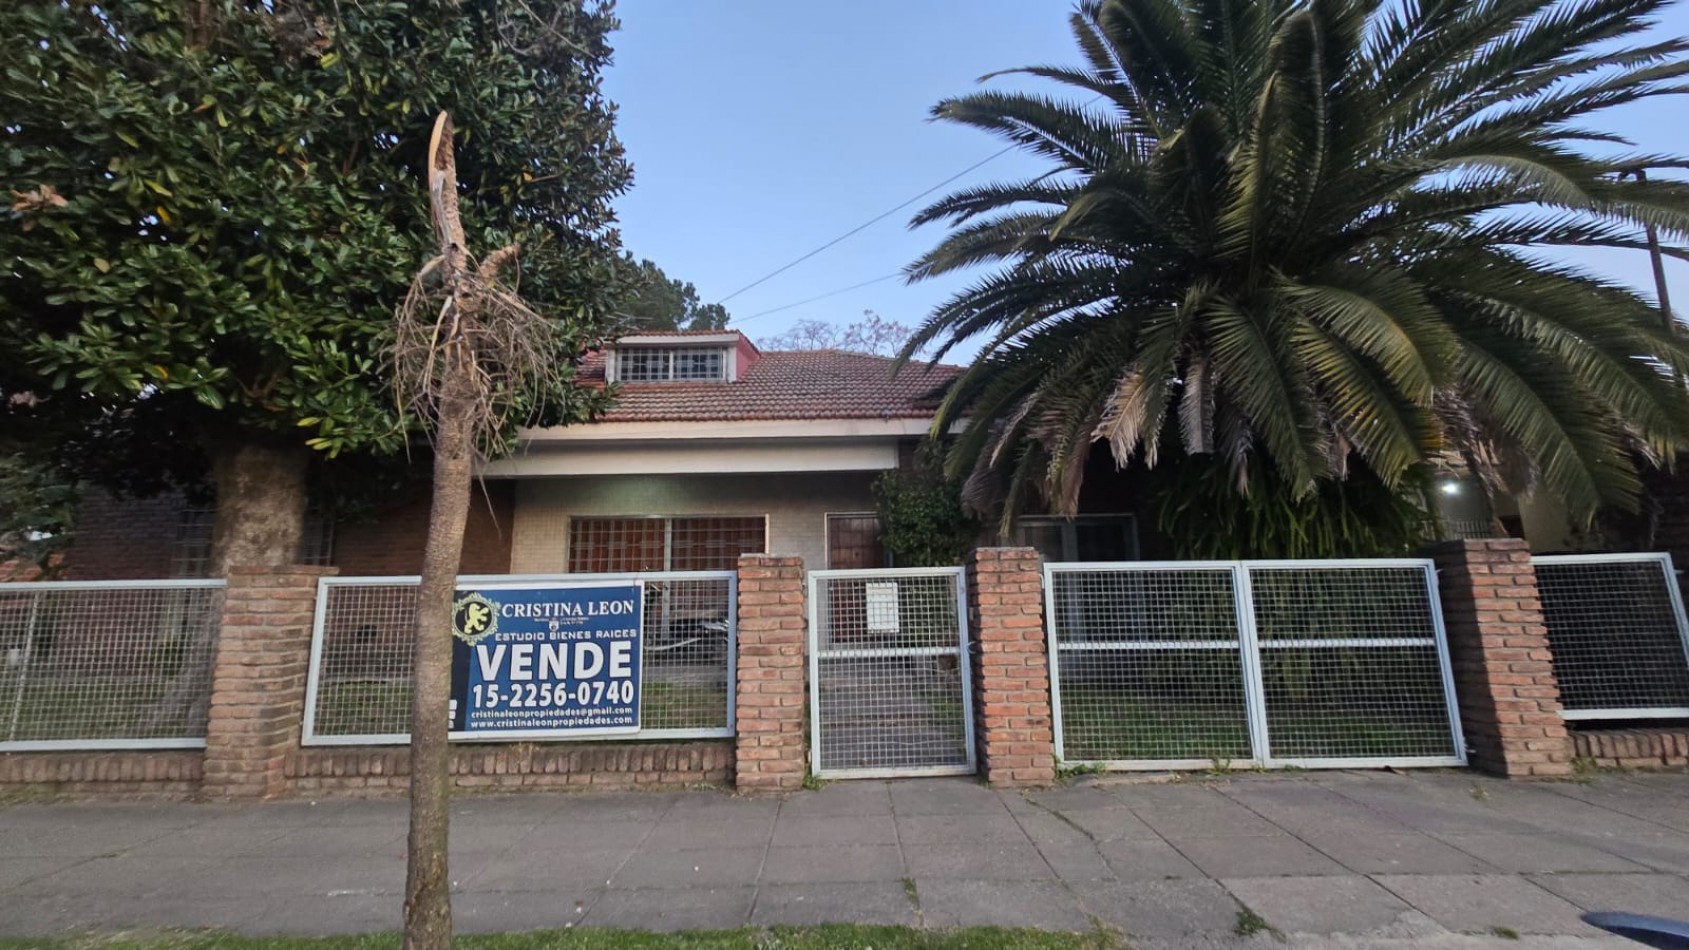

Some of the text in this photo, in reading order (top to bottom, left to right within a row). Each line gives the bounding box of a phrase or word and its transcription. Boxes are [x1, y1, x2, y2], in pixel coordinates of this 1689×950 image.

[502, 600, 634, 617] CRISTINA LEON
[495, 629, 637, 641] ESTUDIO BIENES RAICES
[477, 641, 632, 681] VENDE
[473, 680, 634, 708] 15-2256-0740
[471, 707, 632, 719] cristinaleonpropiedades@gmail.com
[471, 717, 632, 728] www.cristinaleonpropiedades.com
